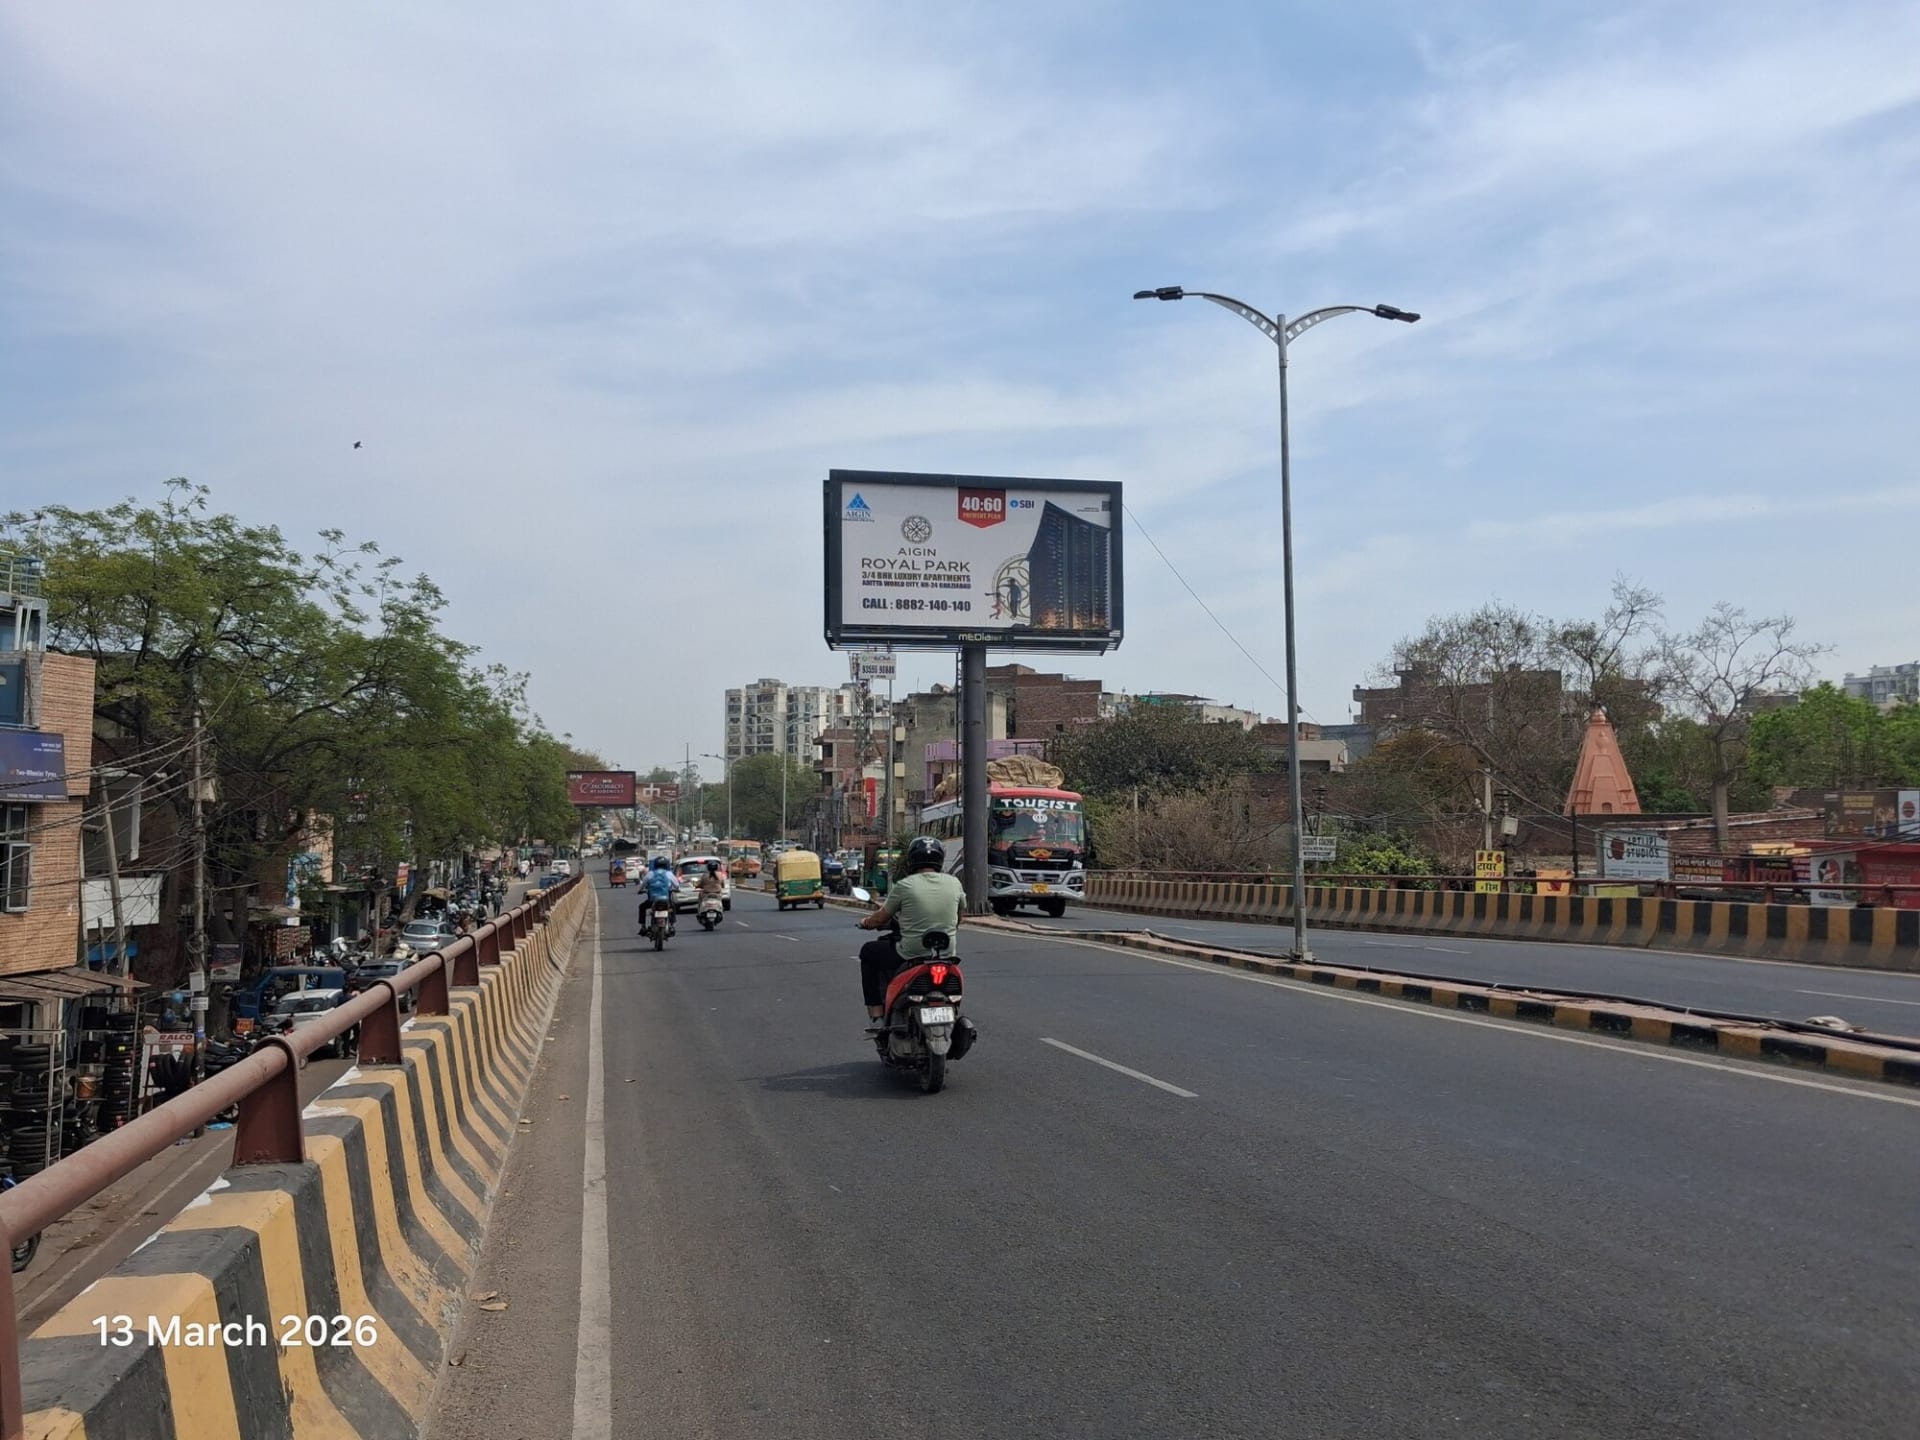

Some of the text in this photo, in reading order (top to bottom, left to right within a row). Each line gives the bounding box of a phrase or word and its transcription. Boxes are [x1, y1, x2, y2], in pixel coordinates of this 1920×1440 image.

[962, 497, 1002, 512] 40:60
[1019, 500, 1035, 509] SBI
[897, 547, 937, 557] AIGIN
[861, 558, 971, 572] ROYAL PARK
[862, 571, 971, 582] 3/4 BHK LUXURY APARTMENTS
[862, 598, 888, 609] CALL
[895, 599, 971, 612] 8882-140-140
[1001, 799, 1077, 811] TOURIST
[1626, 848, 1660, 858] STUDIOS
